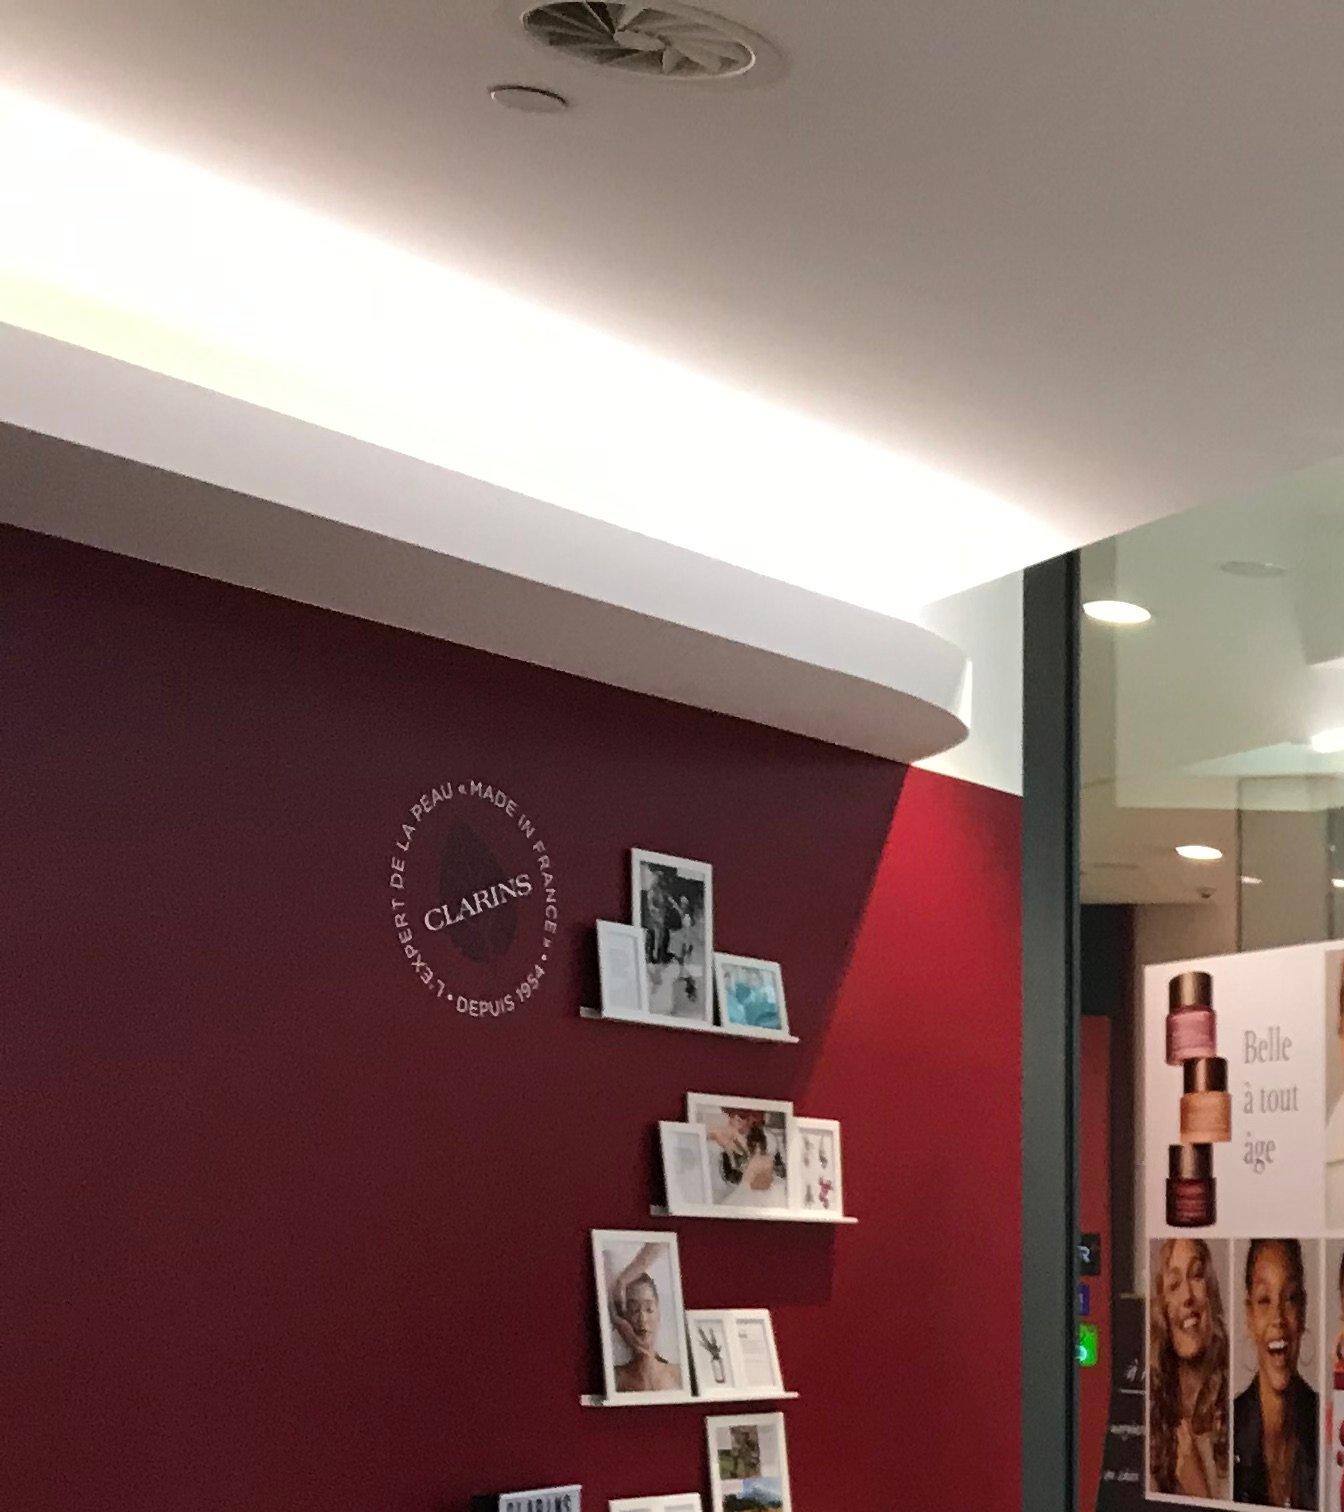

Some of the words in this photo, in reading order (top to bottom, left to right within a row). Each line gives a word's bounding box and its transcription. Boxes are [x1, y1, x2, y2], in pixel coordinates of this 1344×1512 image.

[408, 782, 454, 822] PEAU
[396, 824, 416, 852] LA
[517, 814, 536, 838] IN
[389, 857, 405, 889] DE
[424, 874, 533, 931] CLARINS
[456, 994, 515, 1017] DEPUIS
[516, 964, 546, 1002] 1954
[1243, 1025, 1293, 1065] Belle
[1243, 1083, 1254, 1115] à
[1260, 1084, 1300, 1114] tout
[1243, 1130, 1276, 1174] âge
